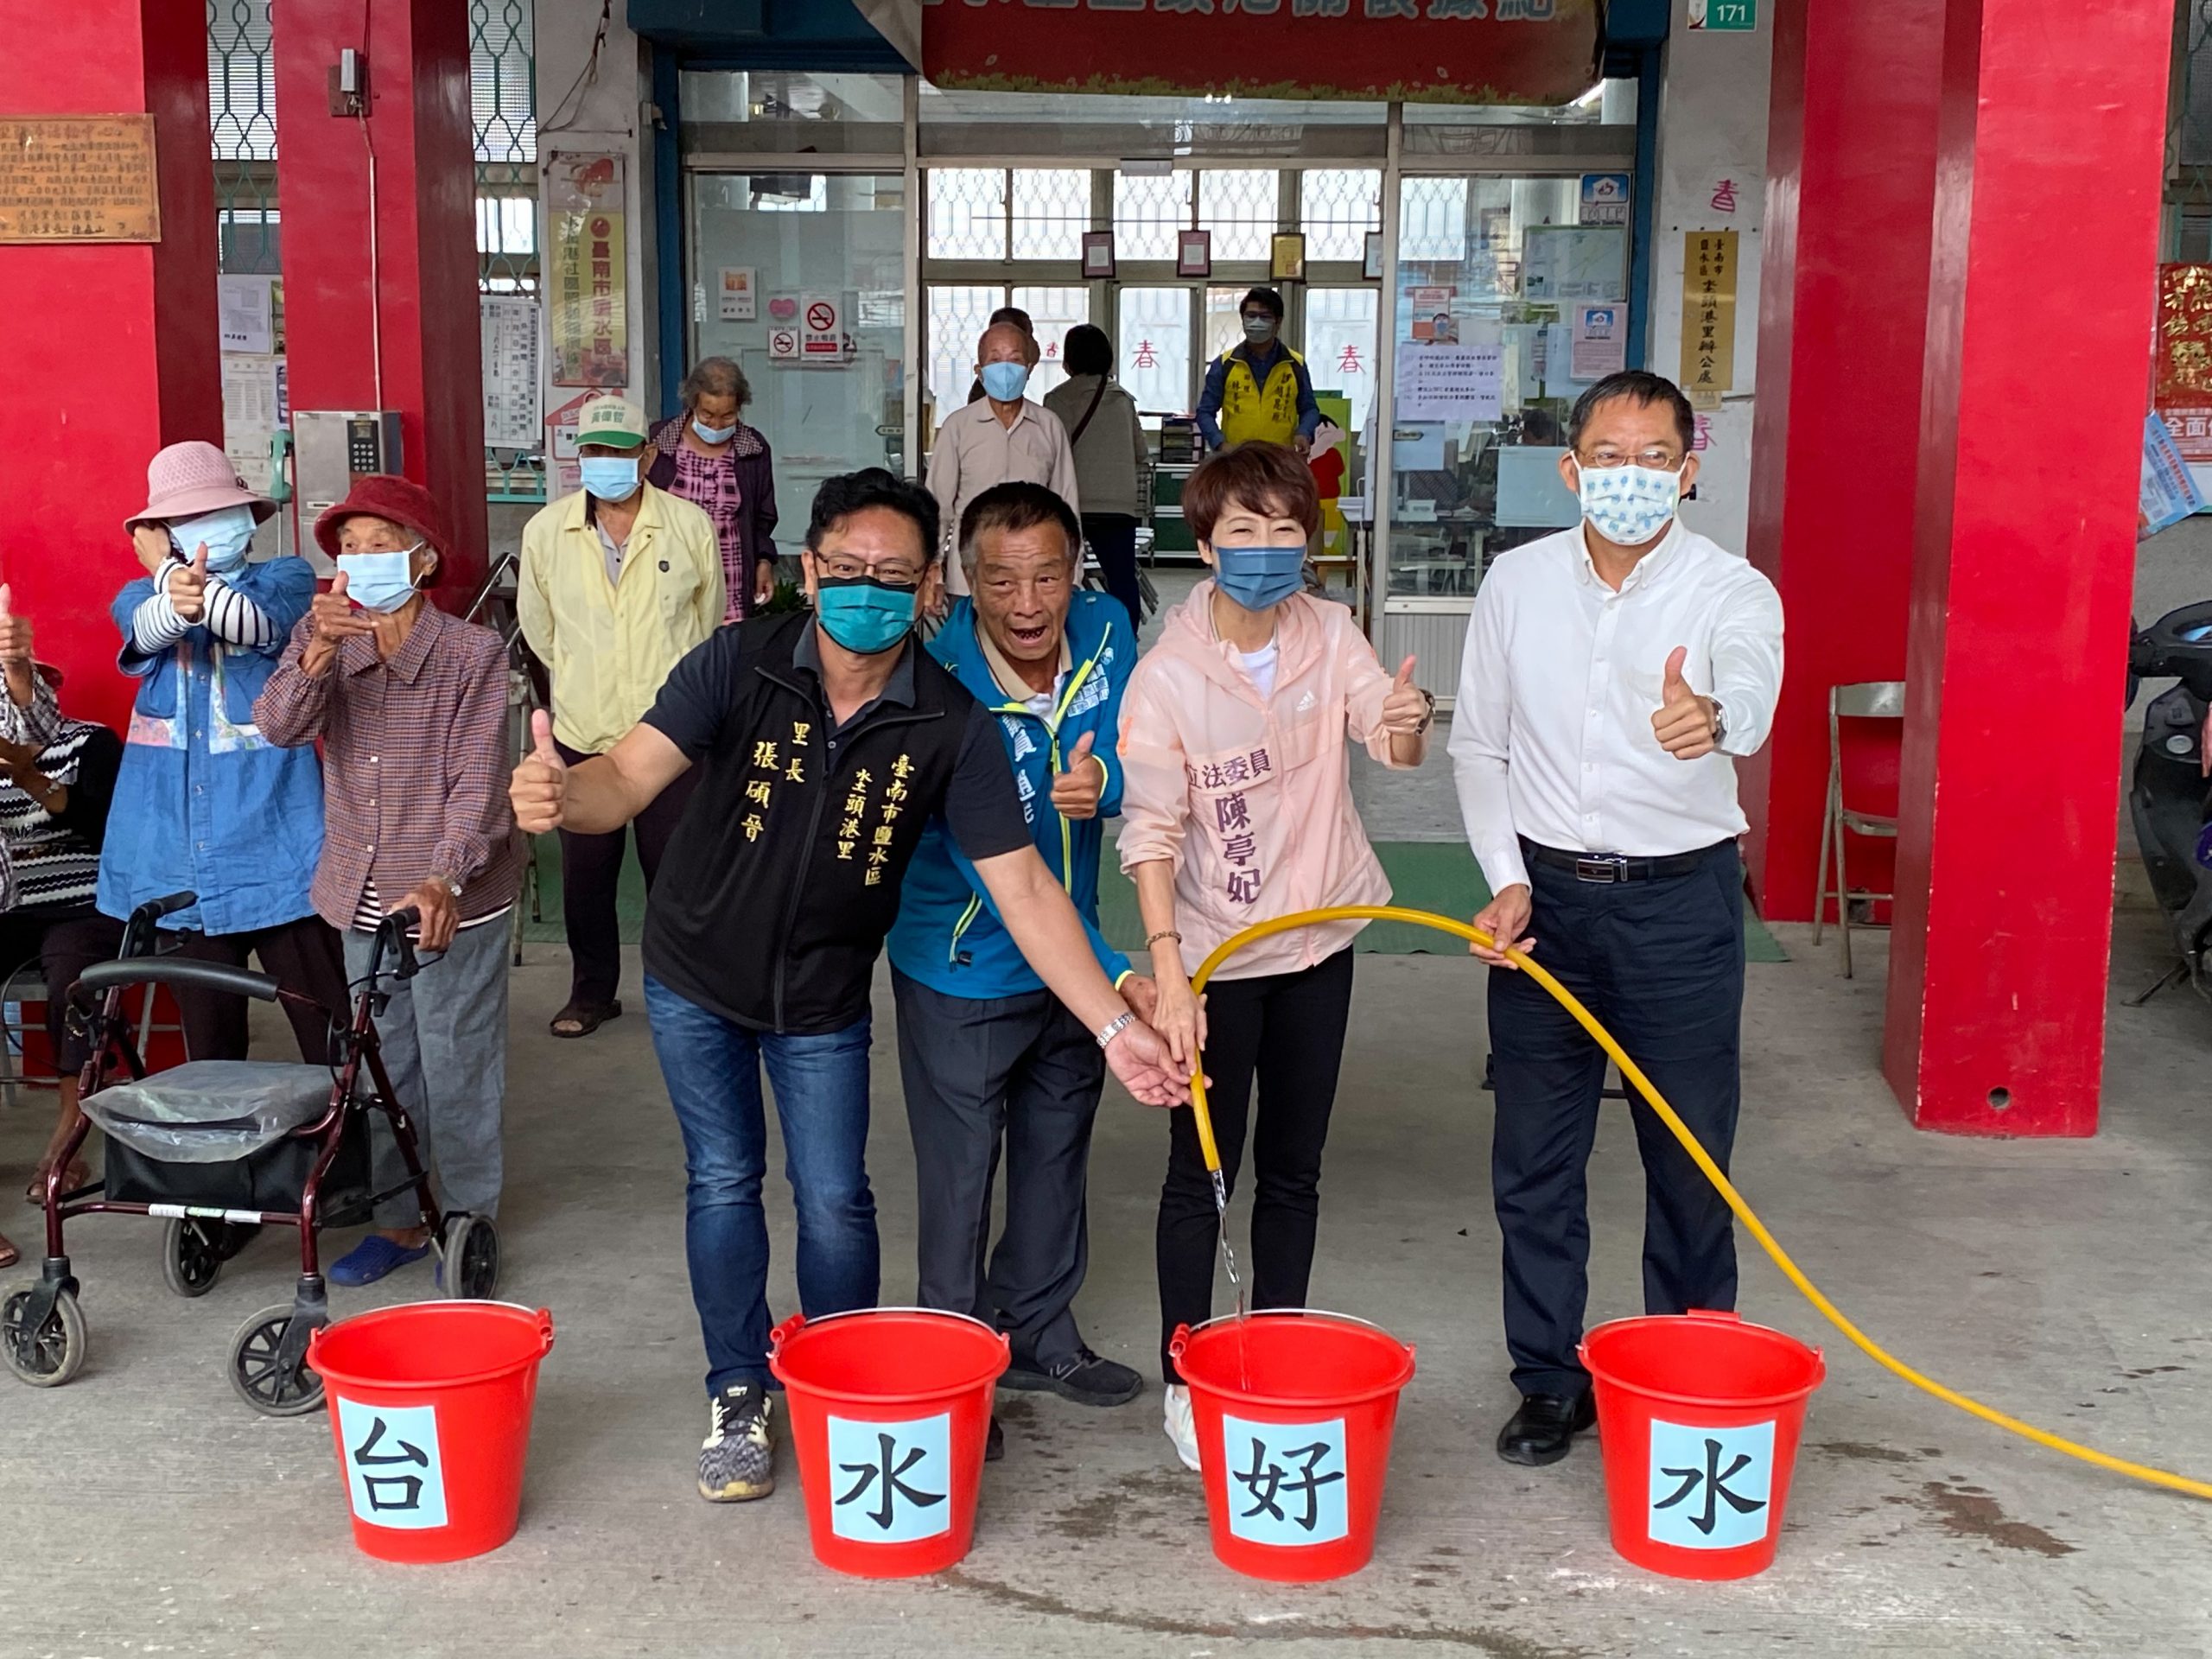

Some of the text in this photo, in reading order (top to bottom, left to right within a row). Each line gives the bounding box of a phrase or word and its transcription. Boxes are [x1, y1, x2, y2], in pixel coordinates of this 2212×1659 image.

[1717, 4, 1745, 22] 171
[1130, 340, 1160, 369] 春
[1337, 345, 1366, 375] 春
[2164, 417, 2212, 437] 全面
[785, 721, 811, 783] 里長
[1186, 748, 1271, 790] 立法委員
[1215, 791, 1262, 905] 陳亭妃
[355, 1417, 429, 1510] 台
[836, 1433, 947, 1529] 水
[1233, 1437, 1344, 1531] 好
[1654, 1439, 1767, 1535] 水
